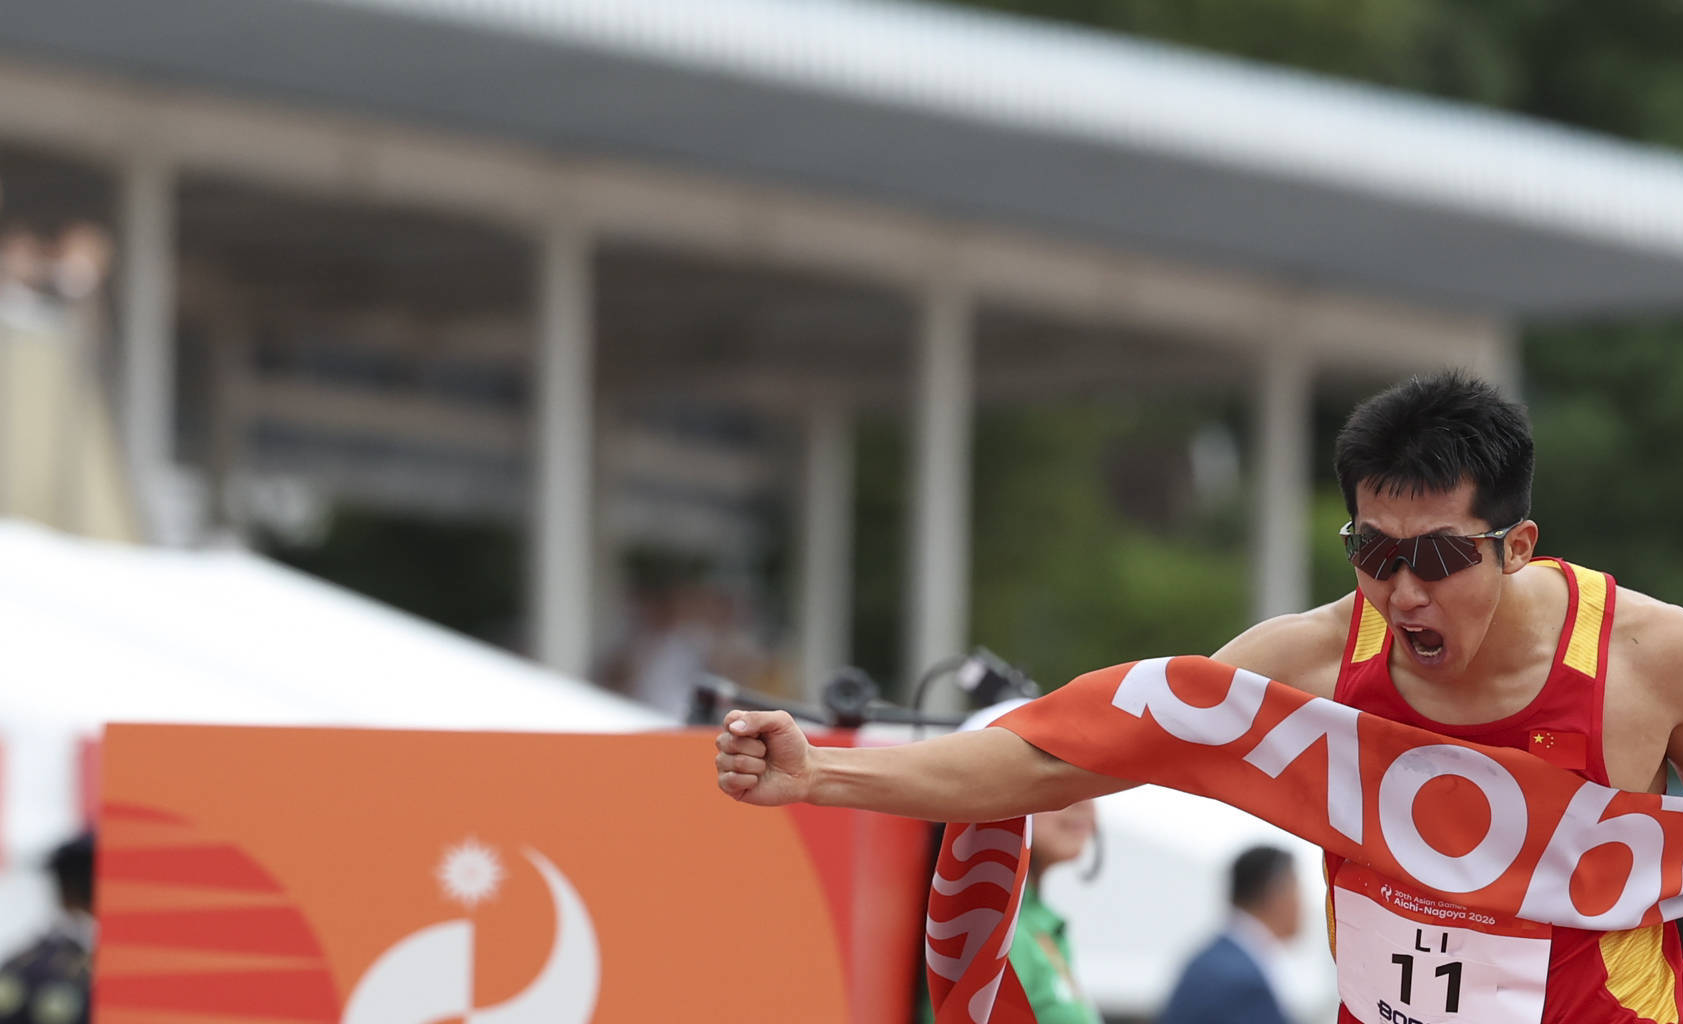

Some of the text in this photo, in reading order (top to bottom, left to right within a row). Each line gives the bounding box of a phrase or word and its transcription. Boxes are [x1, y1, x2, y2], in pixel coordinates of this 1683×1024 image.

[1394, 897, 1496, 925] Aichi-Nagoya 2026
[1395, 890, 1412, 901] 20th
[1413, 896, 1436, 907] Asian
[1415, 928, 1448, 953] LI
[1391, 953, 1463, 1013] 11
